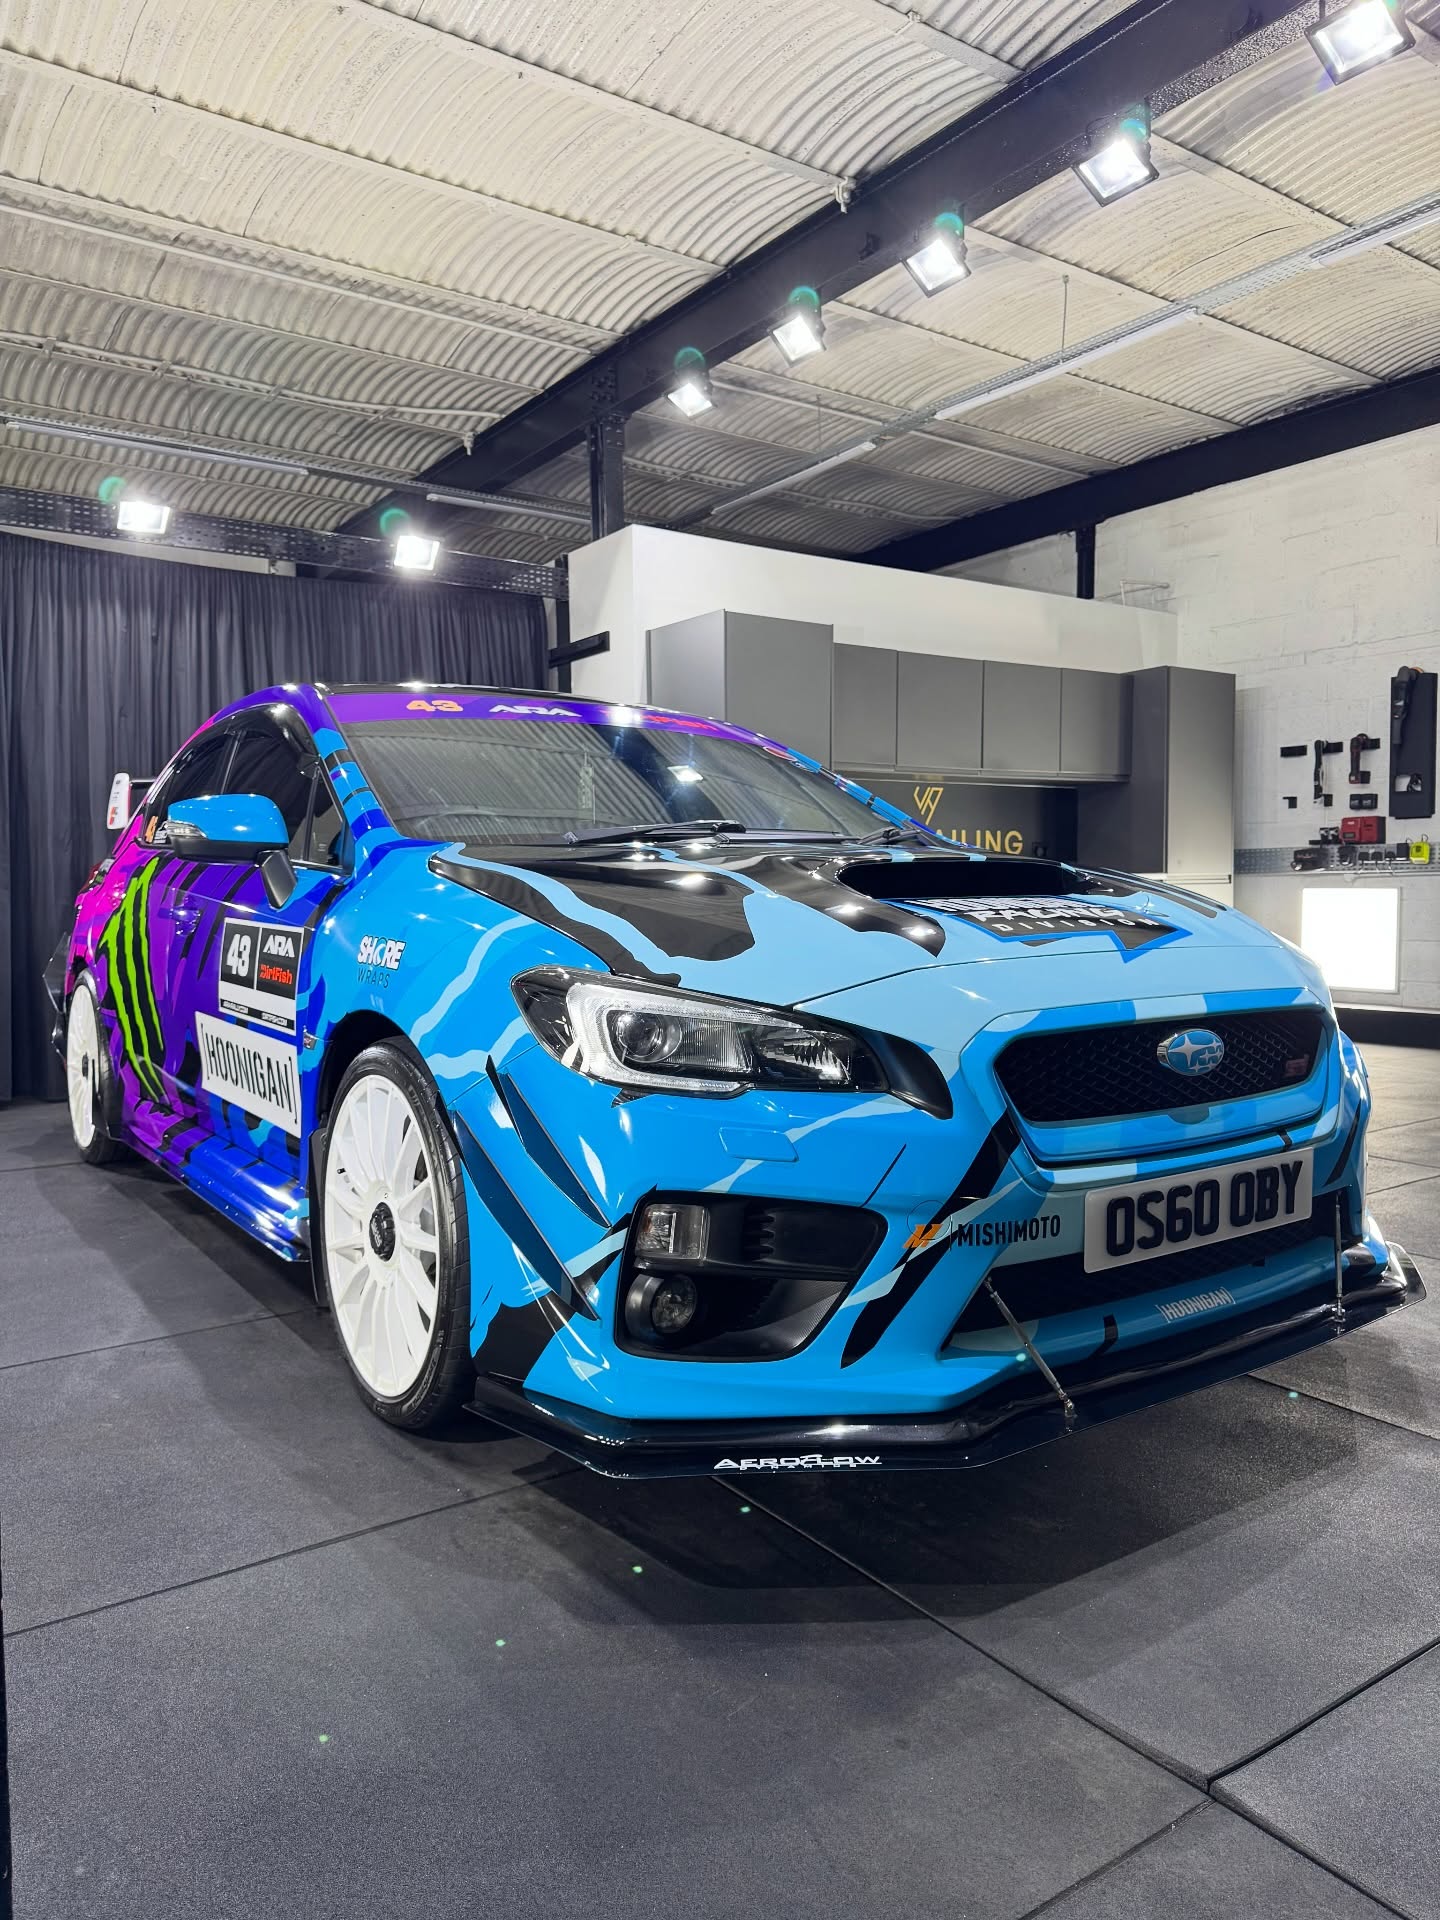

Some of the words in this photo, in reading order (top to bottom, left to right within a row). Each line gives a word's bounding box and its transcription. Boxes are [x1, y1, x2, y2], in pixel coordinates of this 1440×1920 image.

[406, 700, 463, 712] 43
[964, 908, 1125, 922] RACING
[992, 918, 1160, 932] DIVISION
[226, 933, 252, 977] 43
[357, 935, 406, 970] SHORE
[357, 967, 390, 989] WRAPS
[1106, 1178, 1220, 1257] OS60
[1230, 1160, 1304, 1228] OBY
[957, 1214, 1061, 1248] MISHIMOTO
[713, 1453, 883, 1470] AEROFLOW
